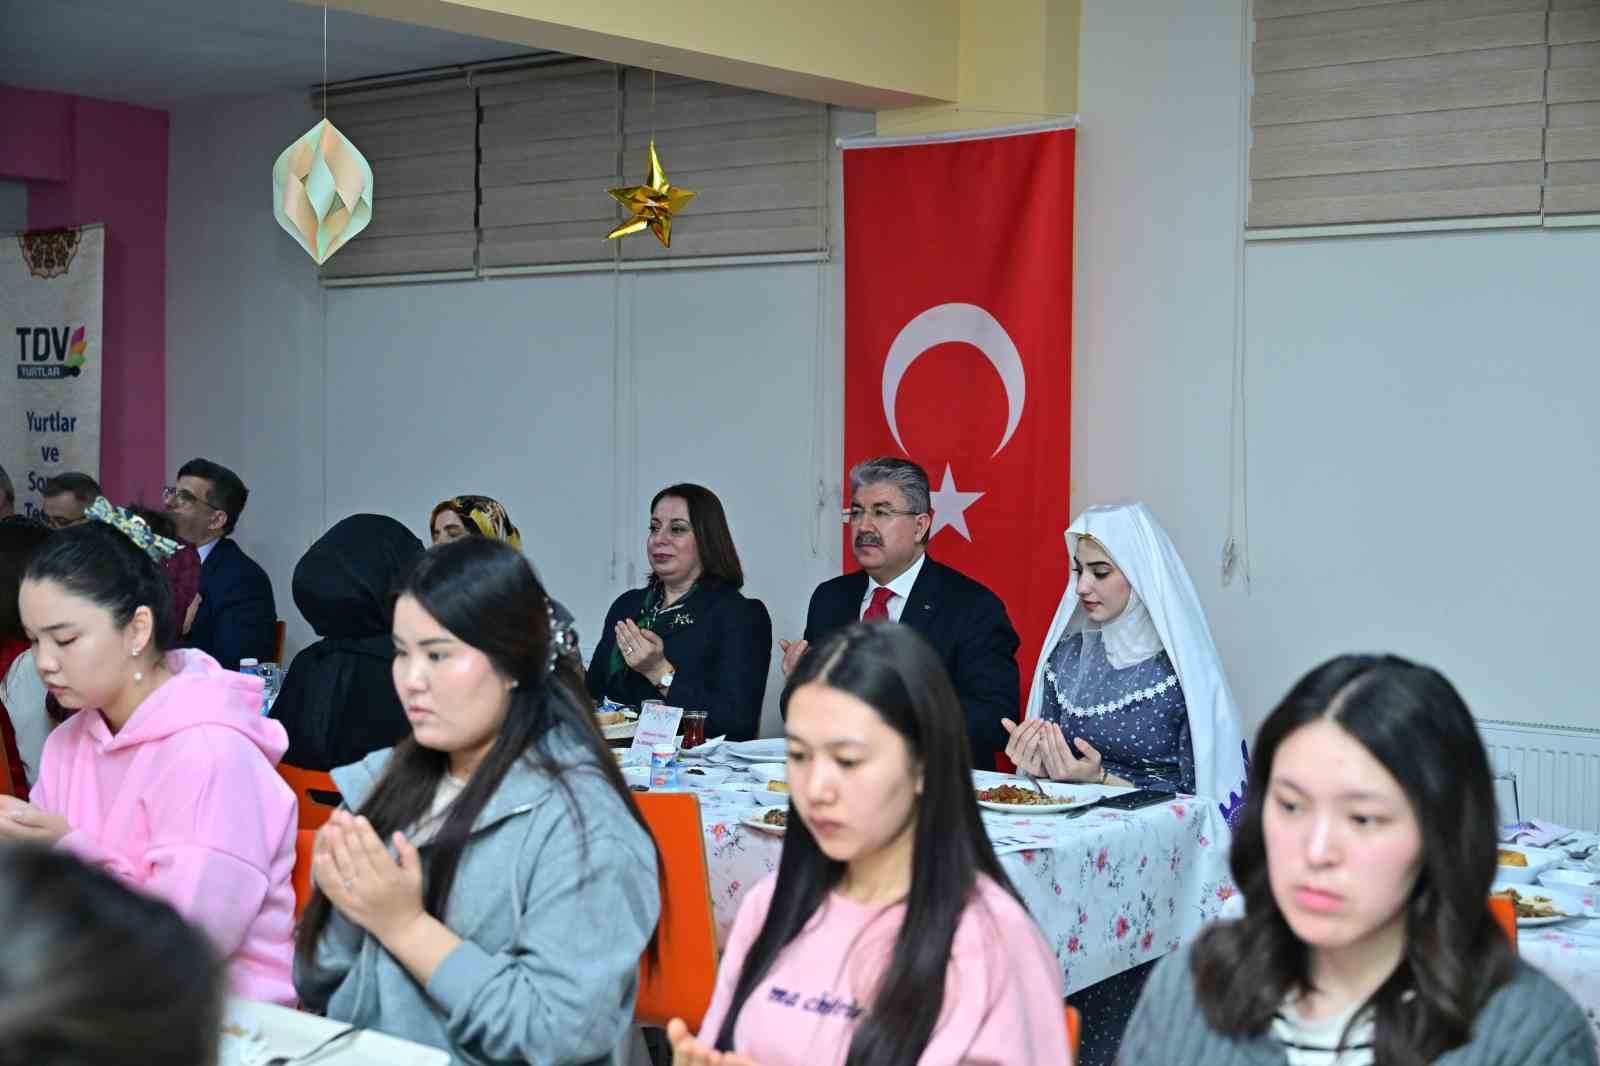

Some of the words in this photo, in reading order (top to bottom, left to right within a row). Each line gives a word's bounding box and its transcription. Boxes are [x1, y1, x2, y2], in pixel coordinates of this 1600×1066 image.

[16, 326, 69, 361] TDV
[22, 367, 60, 377] YURTLAR
[26, 411, 76, 432] Yurtlar
[41, 447, 59, 462] ve
